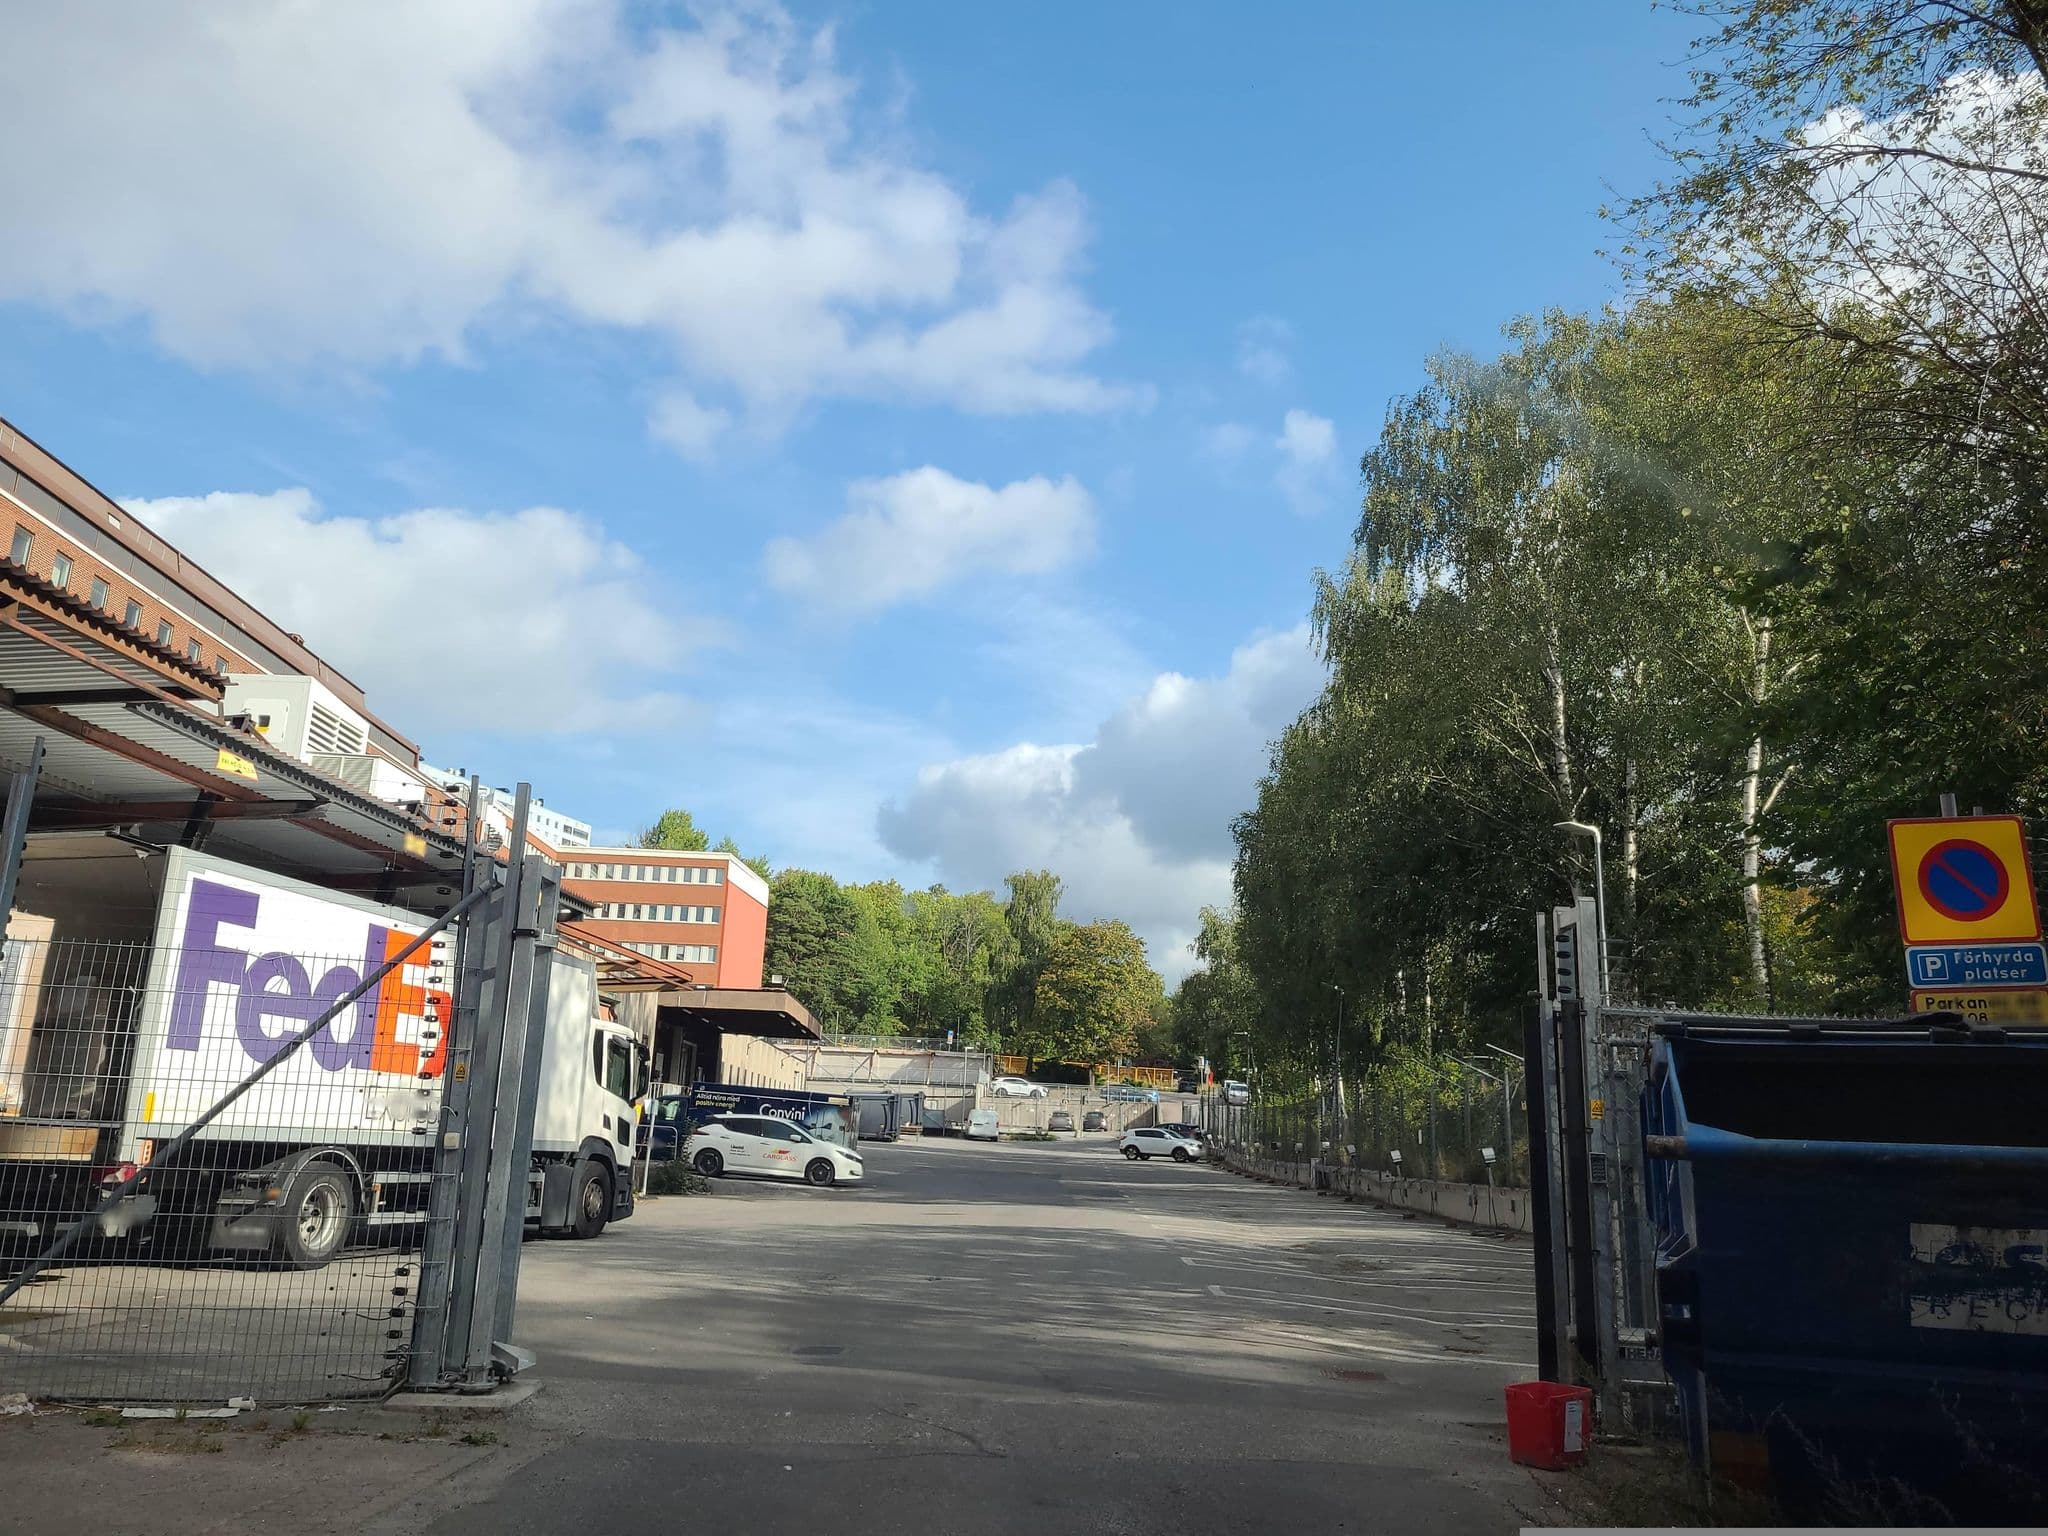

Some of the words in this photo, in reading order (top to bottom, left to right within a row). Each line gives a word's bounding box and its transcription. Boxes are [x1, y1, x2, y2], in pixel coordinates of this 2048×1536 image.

[1954, 951, 2034, 965] Förhyrda
[1965, 968, 2028, 980] platser
[759, 1103, 806, 1121] Convini
